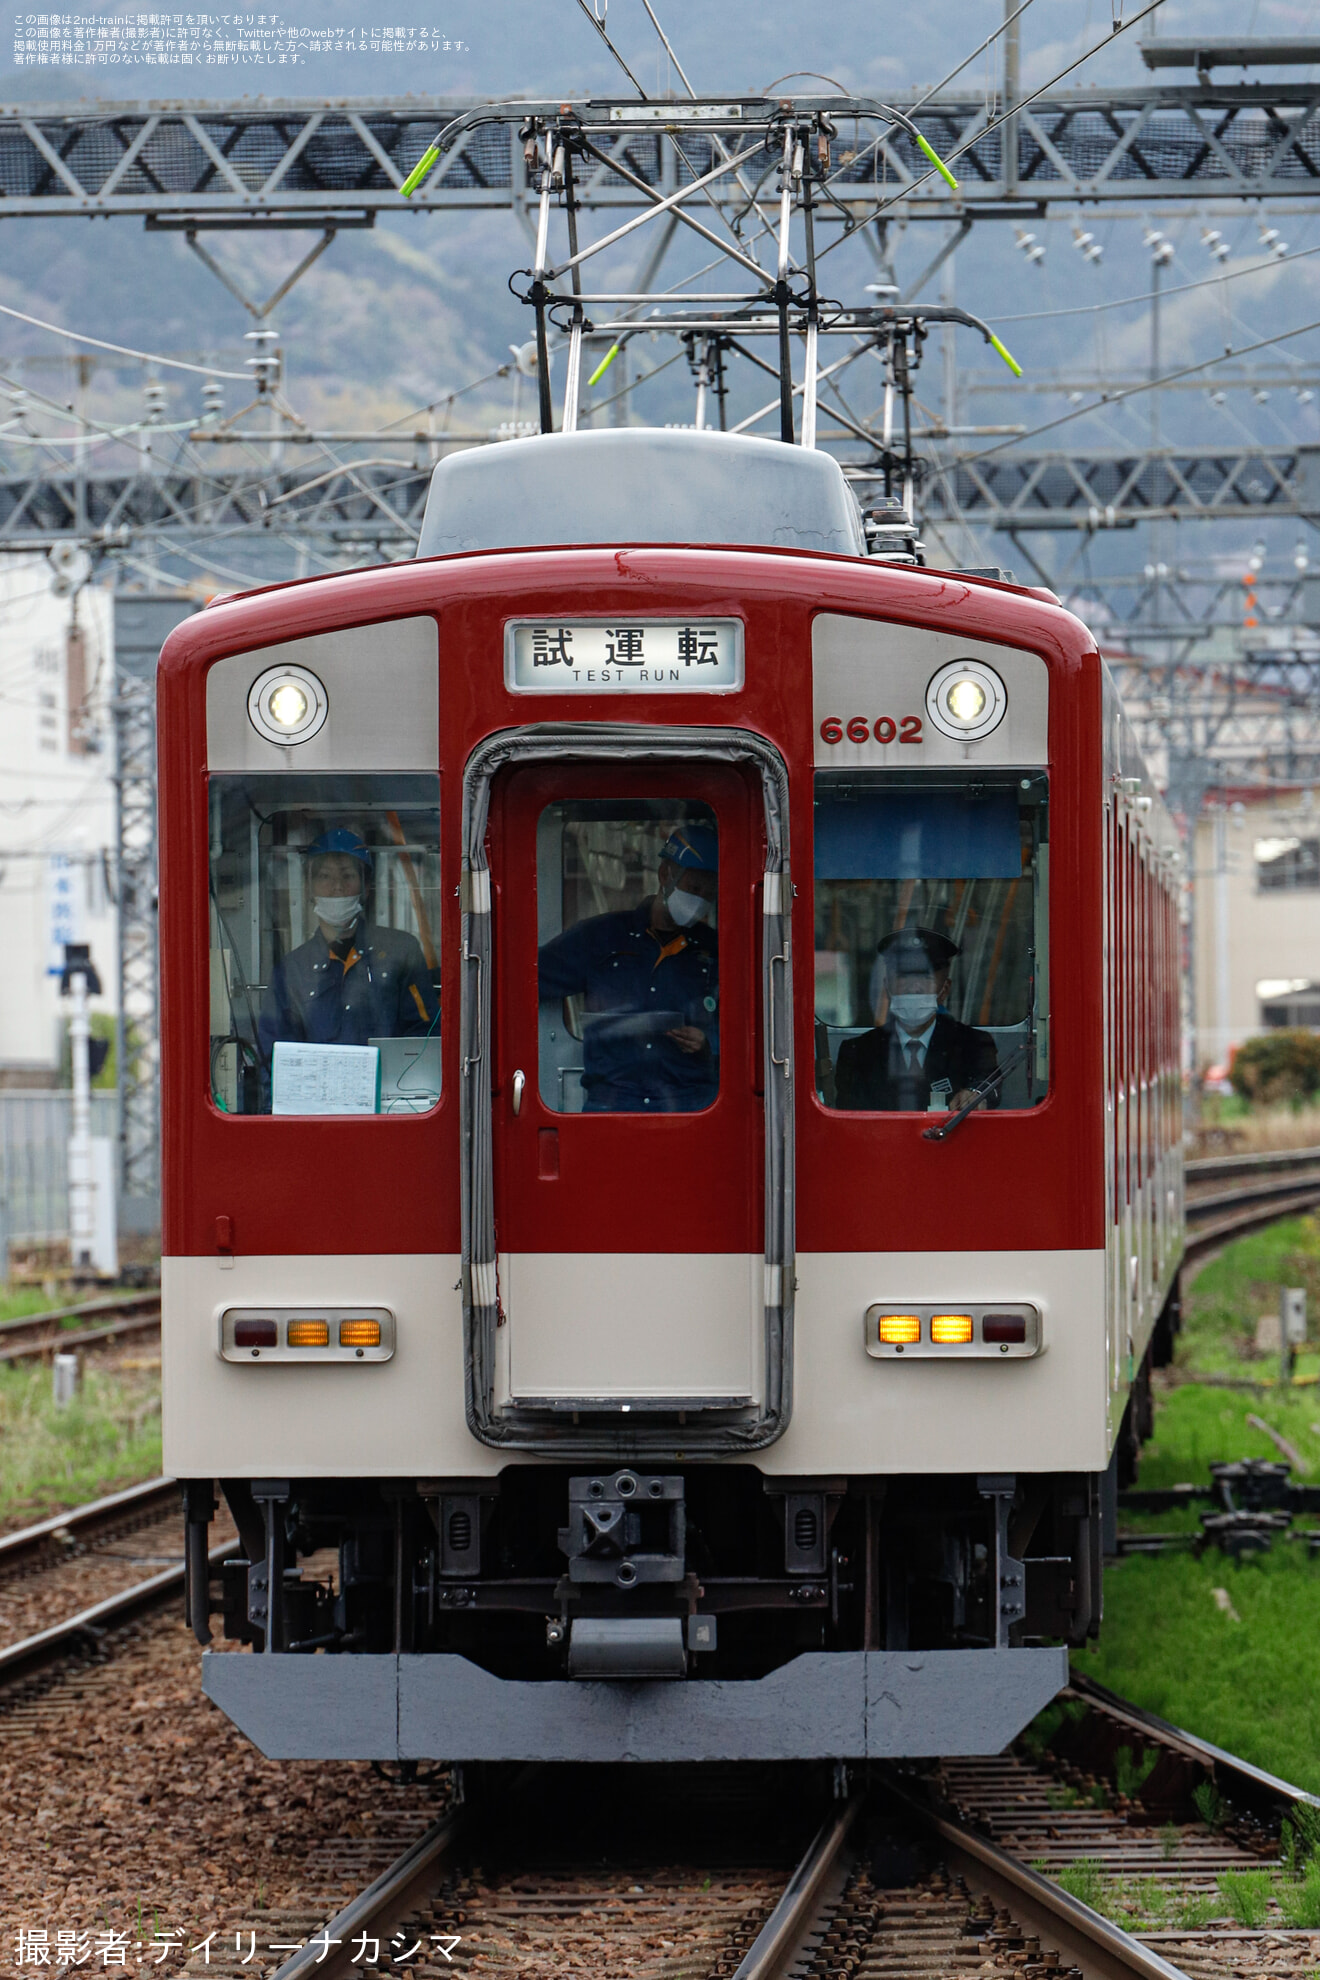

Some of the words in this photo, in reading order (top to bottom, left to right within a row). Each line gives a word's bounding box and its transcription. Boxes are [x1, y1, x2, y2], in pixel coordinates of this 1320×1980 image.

[532, 627, 719, 667] 試運転
[573, 669, 624, 682] TEST
[640, 669, 680, 682] RUN
[820, 715, 923, 744] 6602
